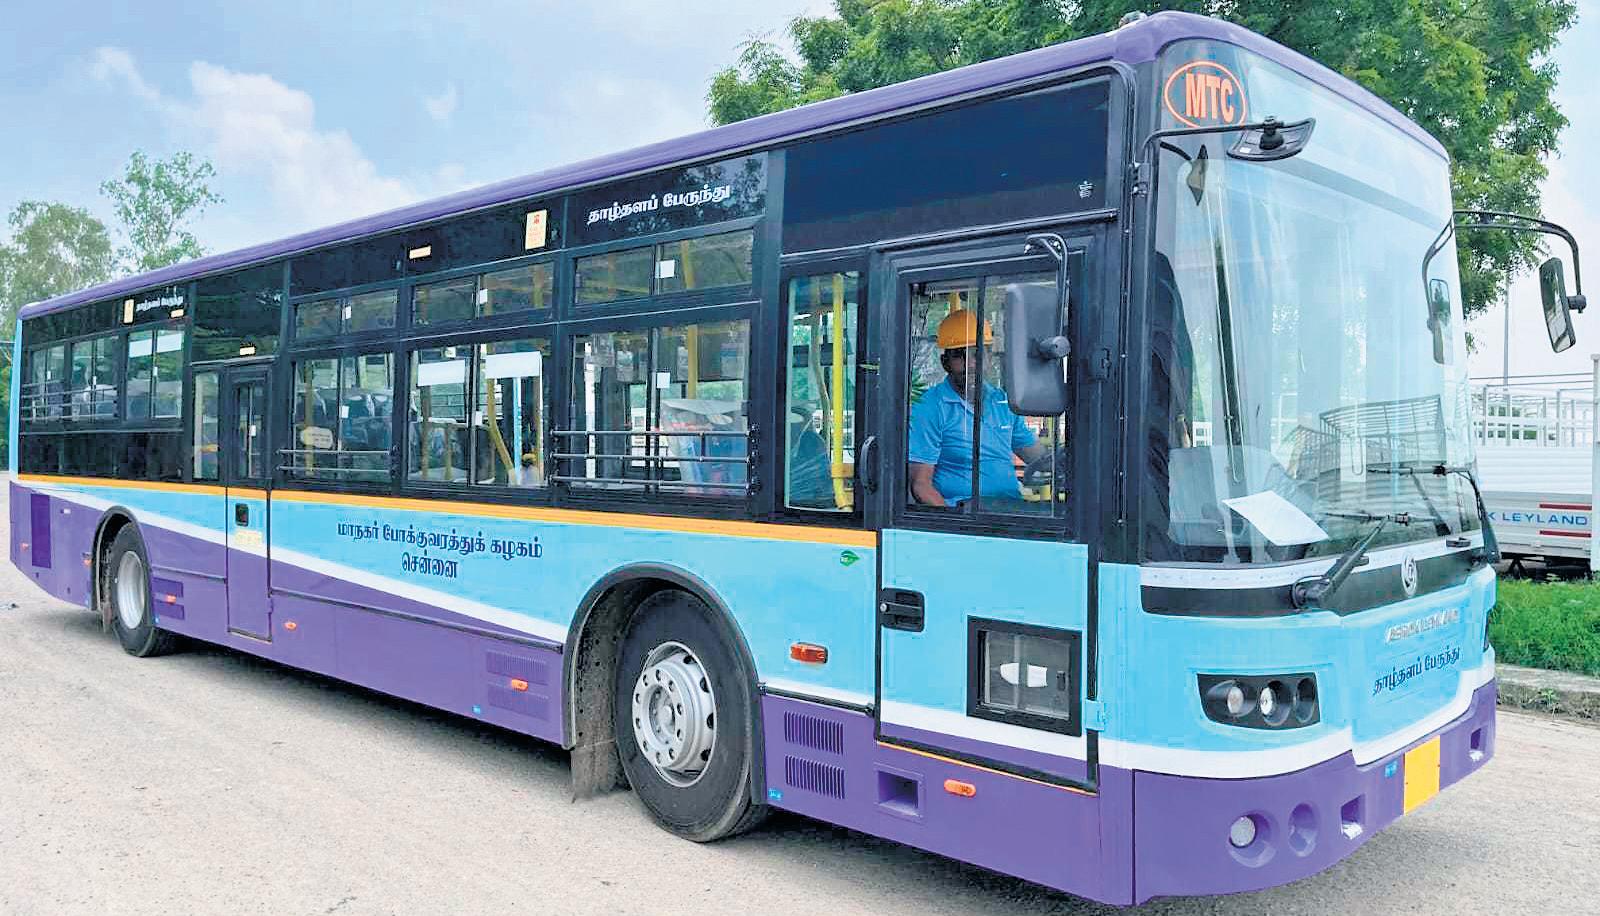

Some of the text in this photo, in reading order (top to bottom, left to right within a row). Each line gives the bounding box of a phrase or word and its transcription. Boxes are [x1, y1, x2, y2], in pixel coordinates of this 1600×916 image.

[1184, 72, 1235, 124] MTC
[587, 184, 731, 225] தாழ்தளப் பேருந்து
[1502, 511, 1588, 526] LEYLAND
[337, 520, 543, 561] மாநகர் போக்குவரத்துக் கழகம்
[402, 550, 458, 579] சென்னை
